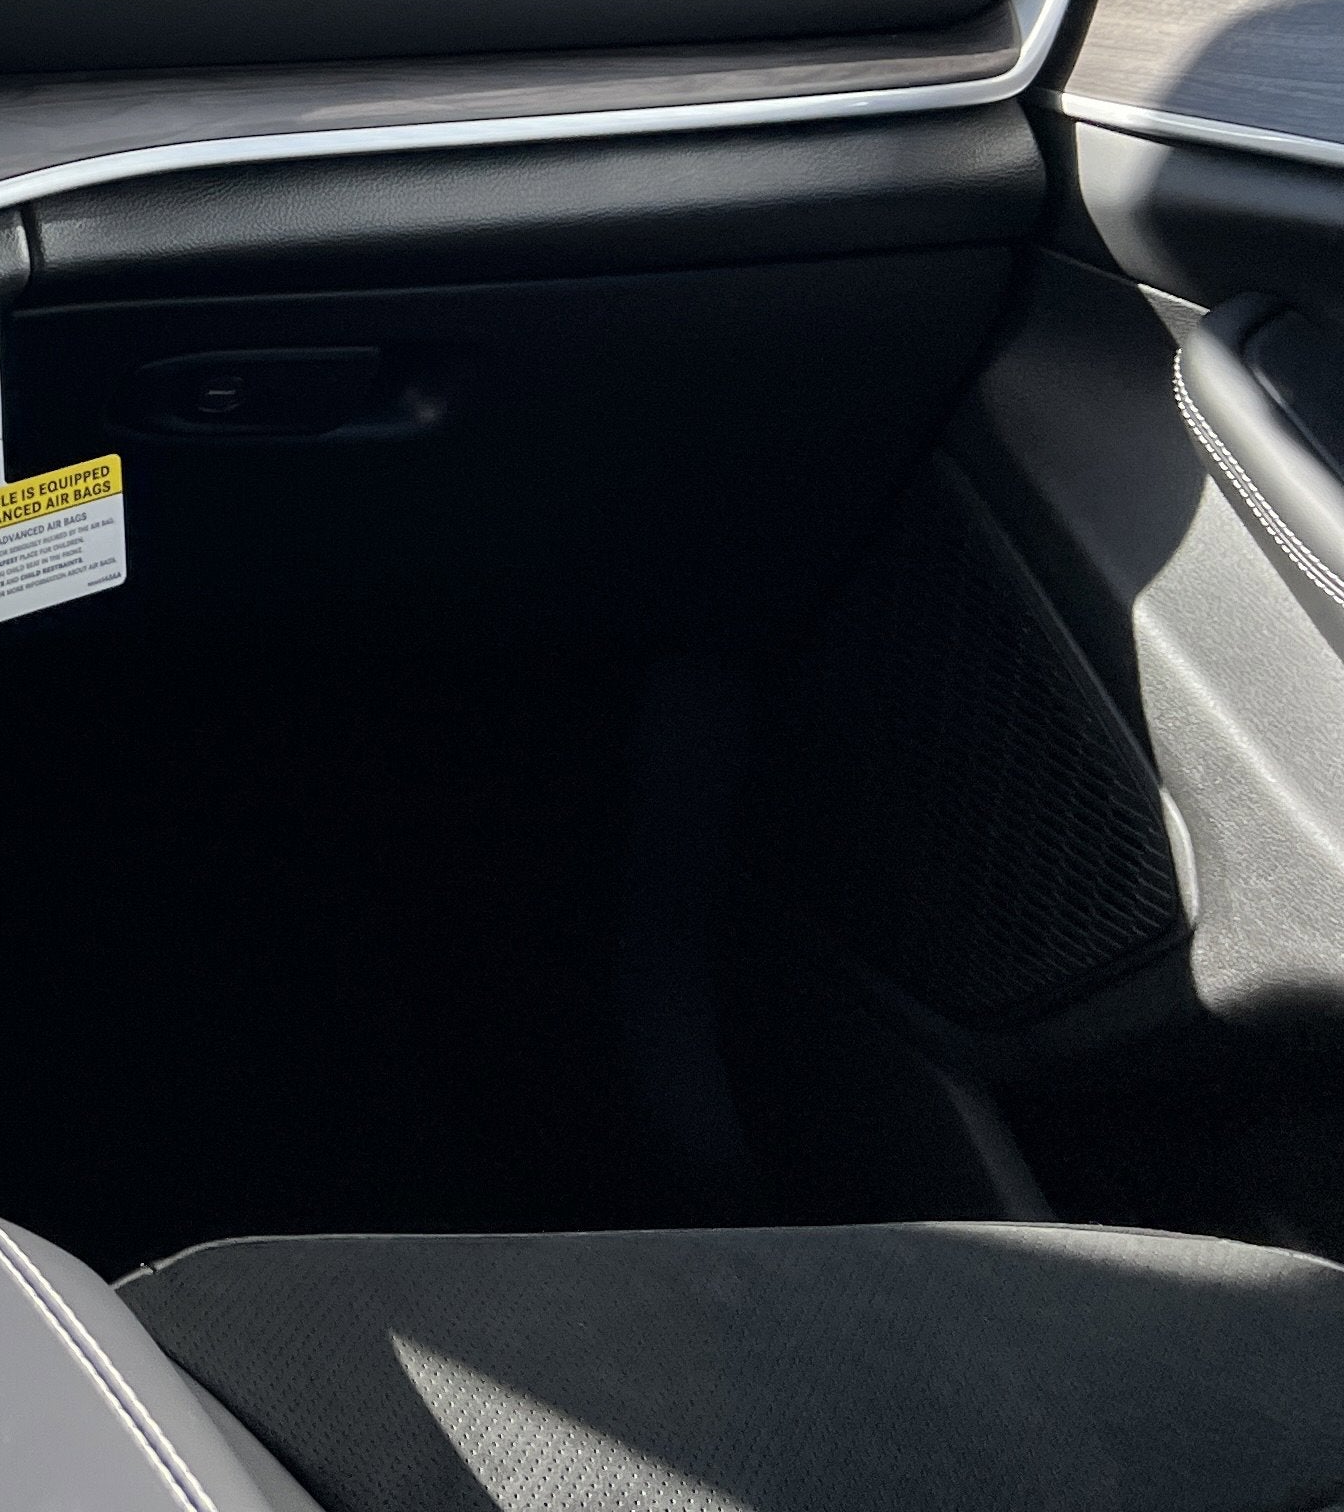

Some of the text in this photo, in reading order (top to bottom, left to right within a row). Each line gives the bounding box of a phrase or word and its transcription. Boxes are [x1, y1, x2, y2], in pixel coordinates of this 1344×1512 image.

[22, 487, 33, 501] IS
[39, 465, 109, 495] EQUIPPED
[46, 493, 68, 509] AIR
[74, 481, 110, 501] BAGS
[47, 521, 60, 531] AIR
[64, 513, 86, 526] BAGS
